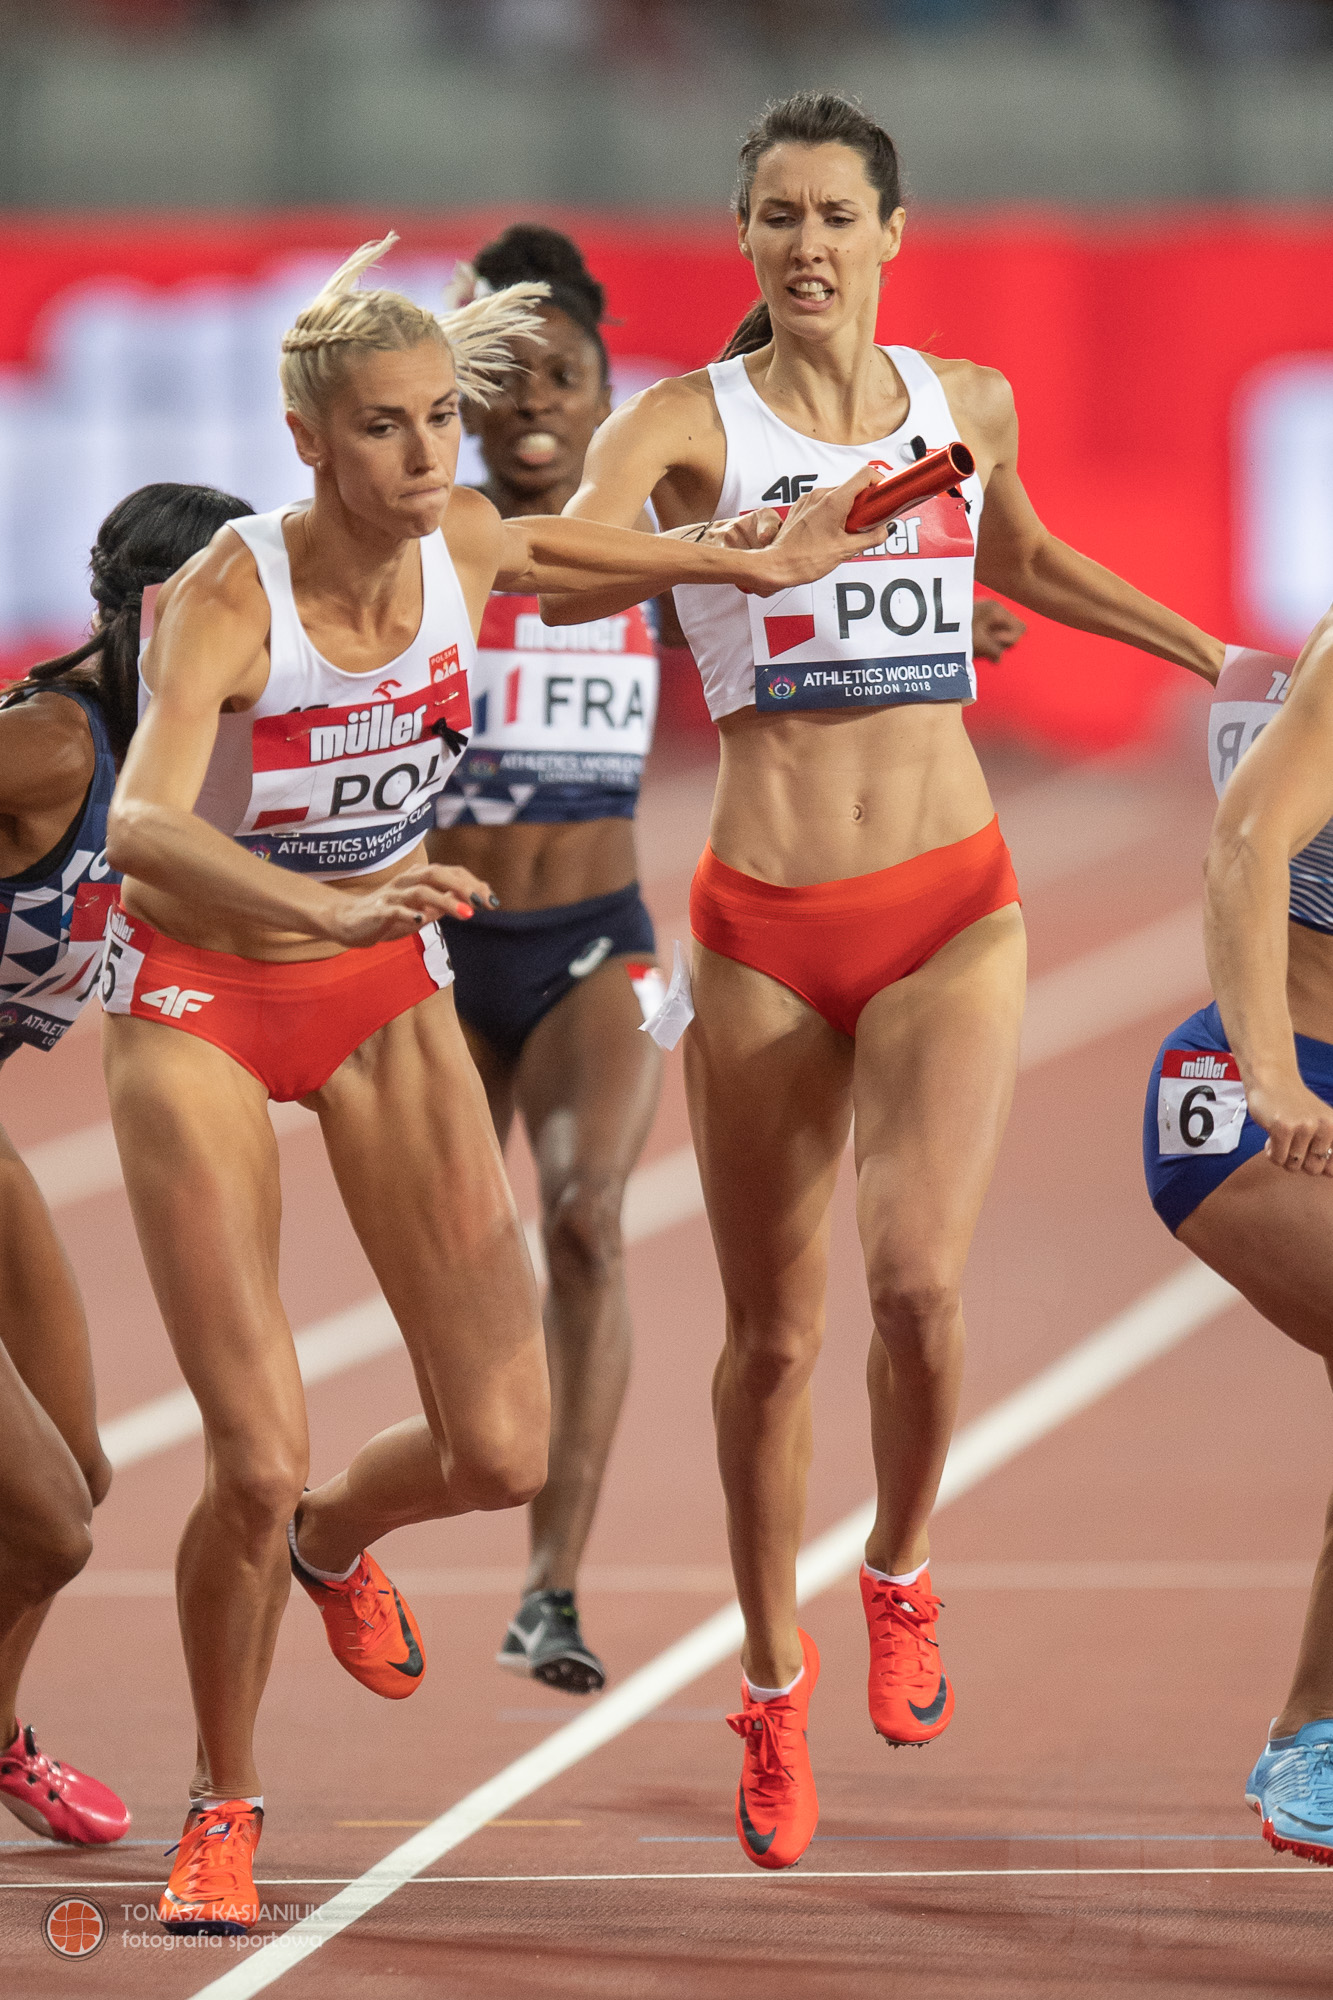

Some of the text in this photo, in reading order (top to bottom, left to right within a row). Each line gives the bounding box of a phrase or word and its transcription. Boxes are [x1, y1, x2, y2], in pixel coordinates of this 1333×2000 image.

[836, 578, 961, 640] POL
[803, 662, 959, 687] ATHLETICS WORLD CUP
[845, 681, 932, 697] LONDON 2018
[543, 676, 645, 729] FRA
[310, 702, 428, 764] müller
[328, 753, 441, 817] POL
[277, 801, 432, 855] ATHLETICS WORLD CUP
[318, 832, 402, 865] LONDON 2018
[140, 985, 215, 1019] 4F
[1180, 1055, 1229, 1079] müller
[1179, 1084, 1217, 1148] 6
